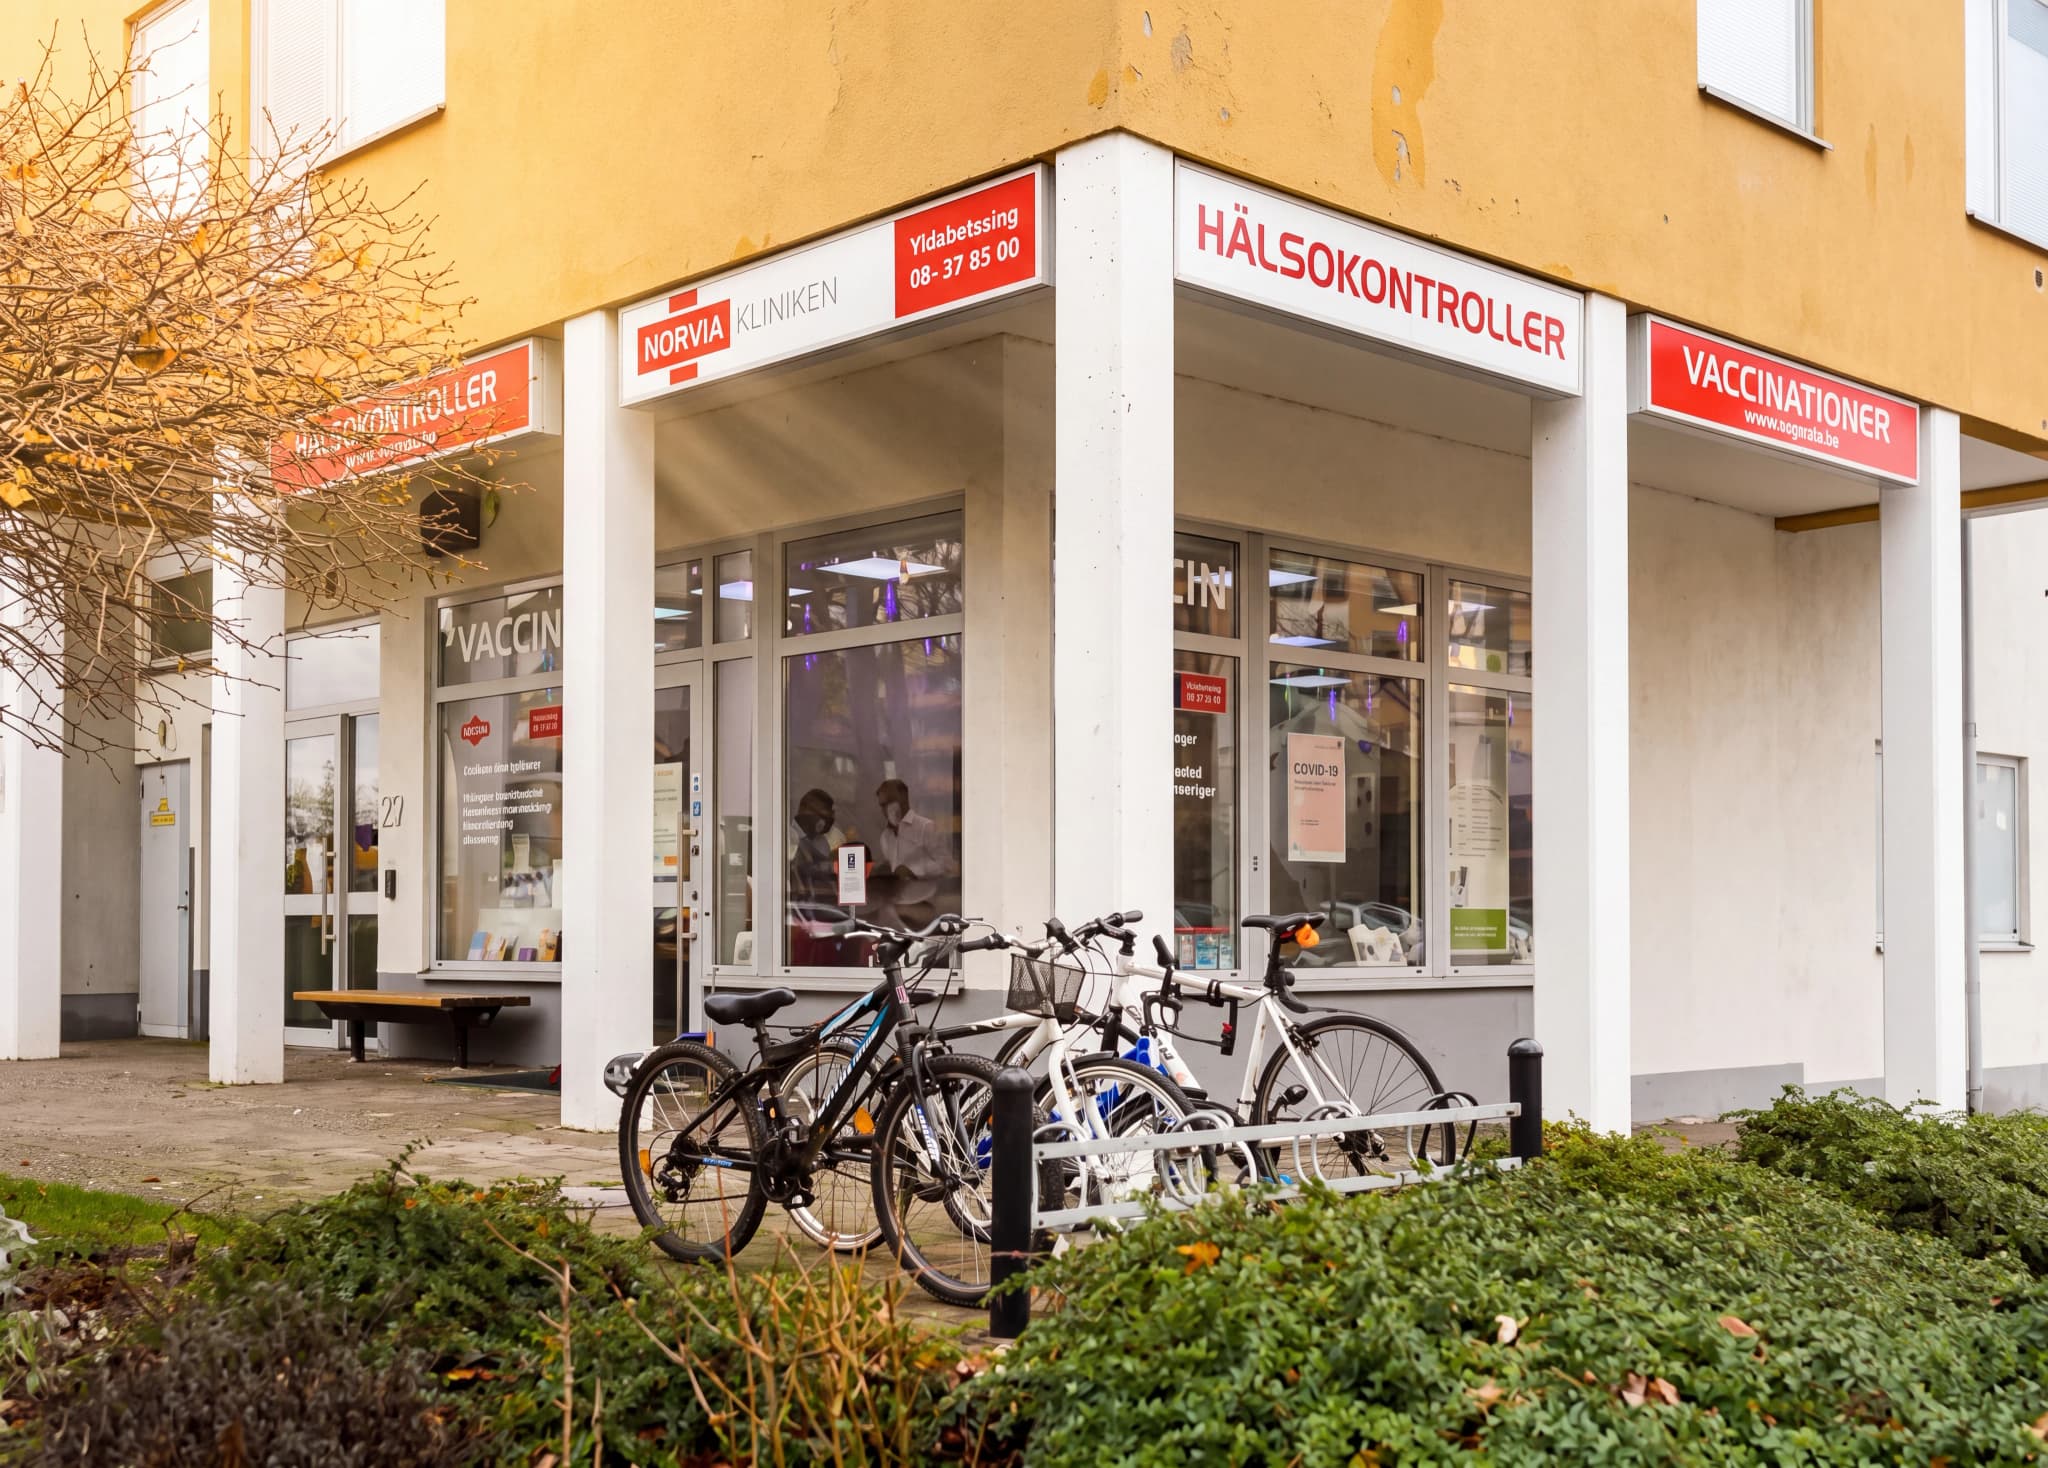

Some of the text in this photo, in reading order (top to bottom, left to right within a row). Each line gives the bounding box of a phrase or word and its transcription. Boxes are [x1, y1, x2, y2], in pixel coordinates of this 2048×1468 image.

[942, 254, 964, 280] 37
[969, 245, 991, 271] 85
[996, 236, 1020, 262] 00
[1198, 202, 1566, 361] HÄLSOKONTROLLER
[737, 276, 837, 335] KLINIKEN
[644, 314, 724, 362] NORVIA
[1682, 345, 1890, 444] VACCINATIONER
[457, 608, 561, 663] VACCIN
[1293, 762, 1339, 777] COVID-19
[381, 794, 404, 828] 27
